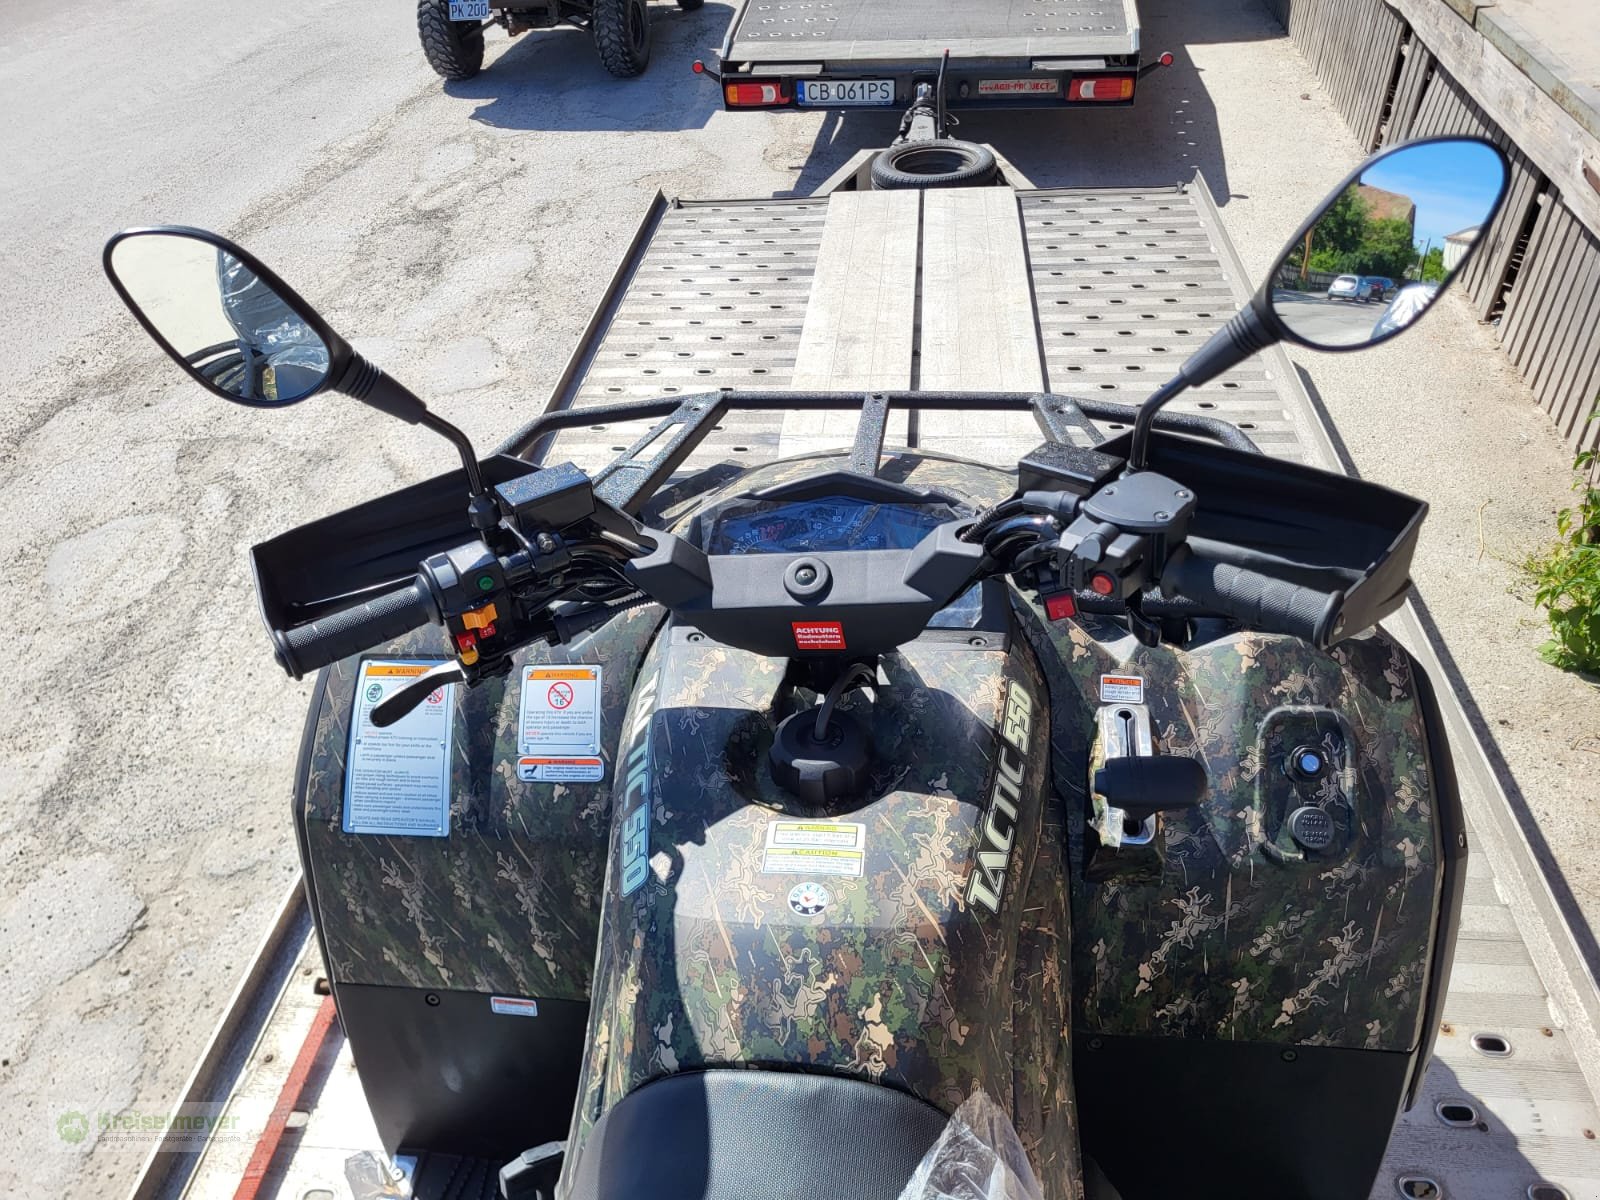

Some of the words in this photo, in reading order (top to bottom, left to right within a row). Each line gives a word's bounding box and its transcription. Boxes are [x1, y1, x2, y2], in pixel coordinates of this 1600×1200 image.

[451, 4, 464, 17] PK
[467, 3, 487, 17] 200
[808, 83, 830, 101] CB
[836, 82, 890, 101] 061PS
[966, 746, 1026, 913] TACTIC
[1002, 679, 1032, 756] 550
[621, 802, 649, 898] 550
